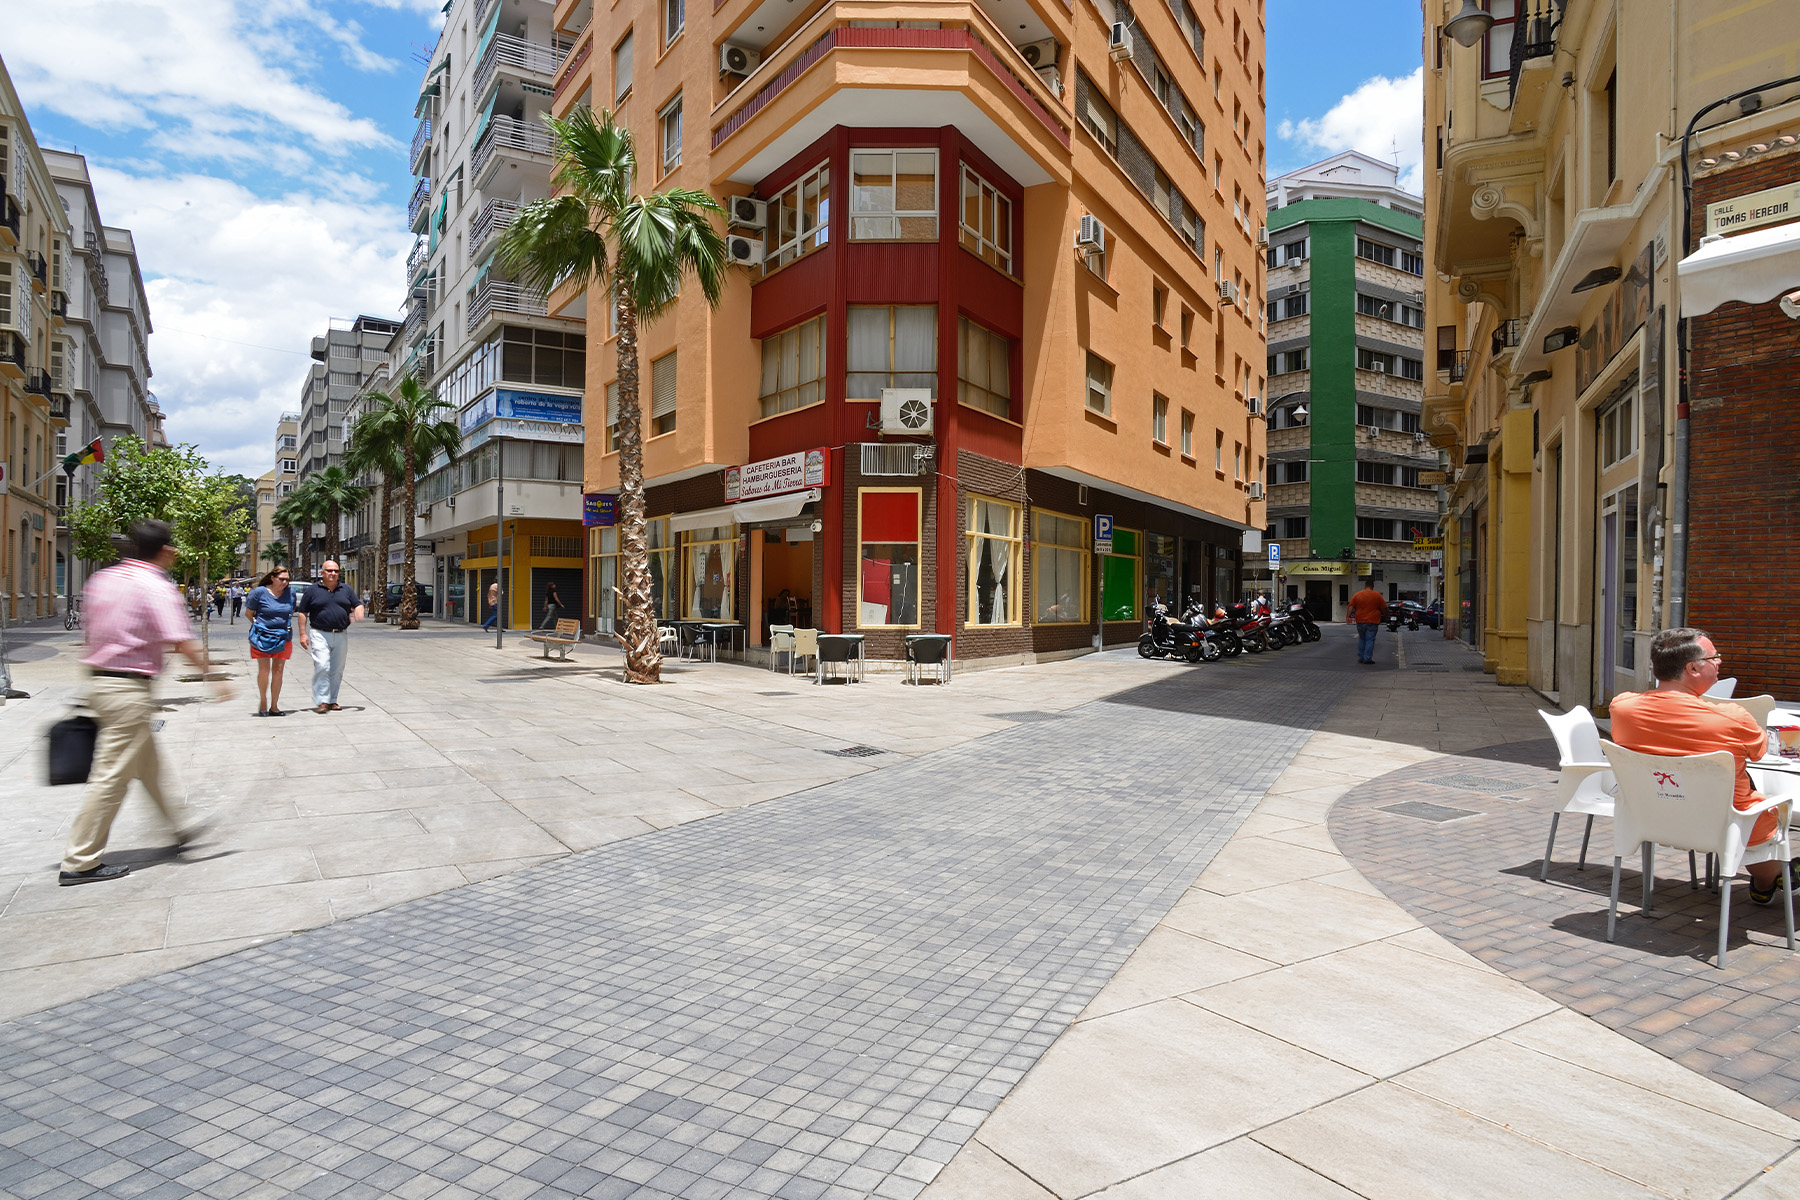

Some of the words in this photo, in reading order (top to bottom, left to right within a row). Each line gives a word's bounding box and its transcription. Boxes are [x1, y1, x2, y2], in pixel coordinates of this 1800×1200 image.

[1714, 205, 1733, 216] CALLE
[1714, 212, 1746, 228] TOMÁS
[1750, 202, 1788, 220] HEREDIA
[500, 420, 579, 436] DERMONOVA
[746, 461, 780, 475] CAFETERIA
[782, 456, 796, 466] BAR
[742, 466, 802, 484] HAMBURGUESERIA
[741, 484, 762, 496] Sabores
[763, 483, 771, 493] de
[772, 480, 782, 491] Mi
[783, 478, 802, 489] Tierra
[1099, 518, 1110, 538] P
